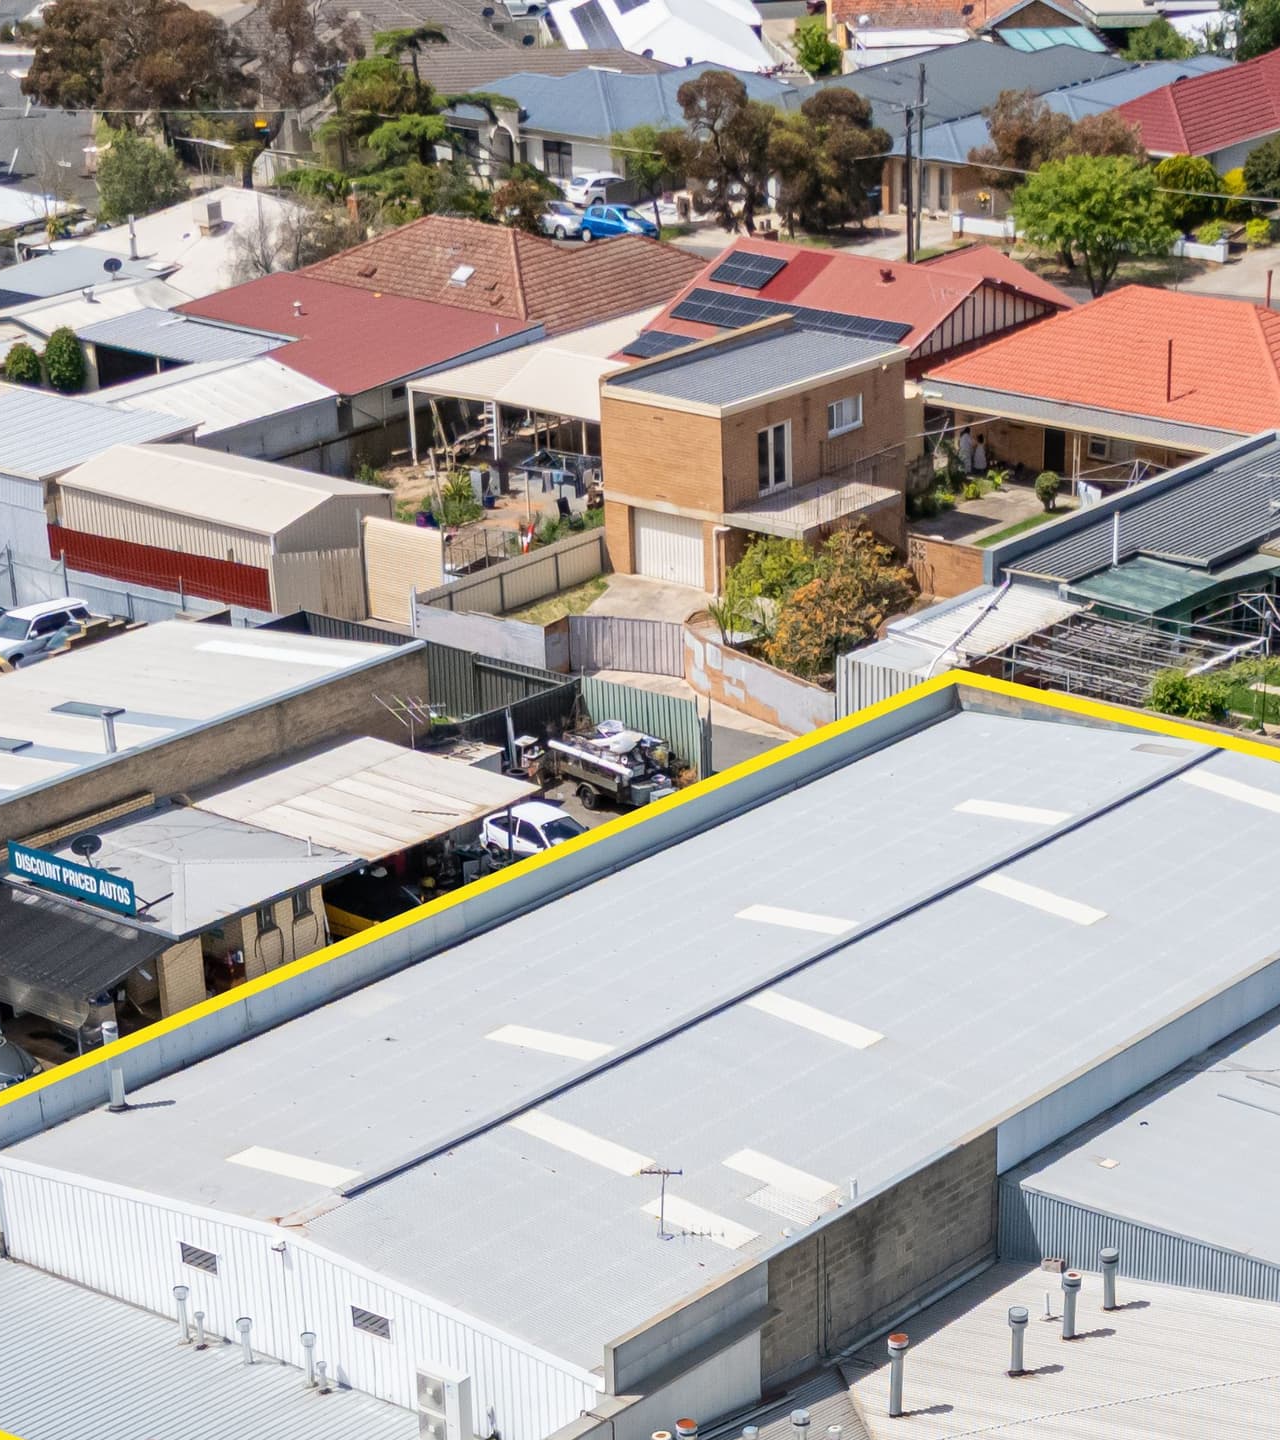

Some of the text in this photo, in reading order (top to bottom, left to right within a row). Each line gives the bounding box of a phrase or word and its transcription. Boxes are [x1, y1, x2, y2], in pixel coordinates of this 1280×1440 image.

[15, 851, 130, 905] DISCOUNT PRICED AUTOS
